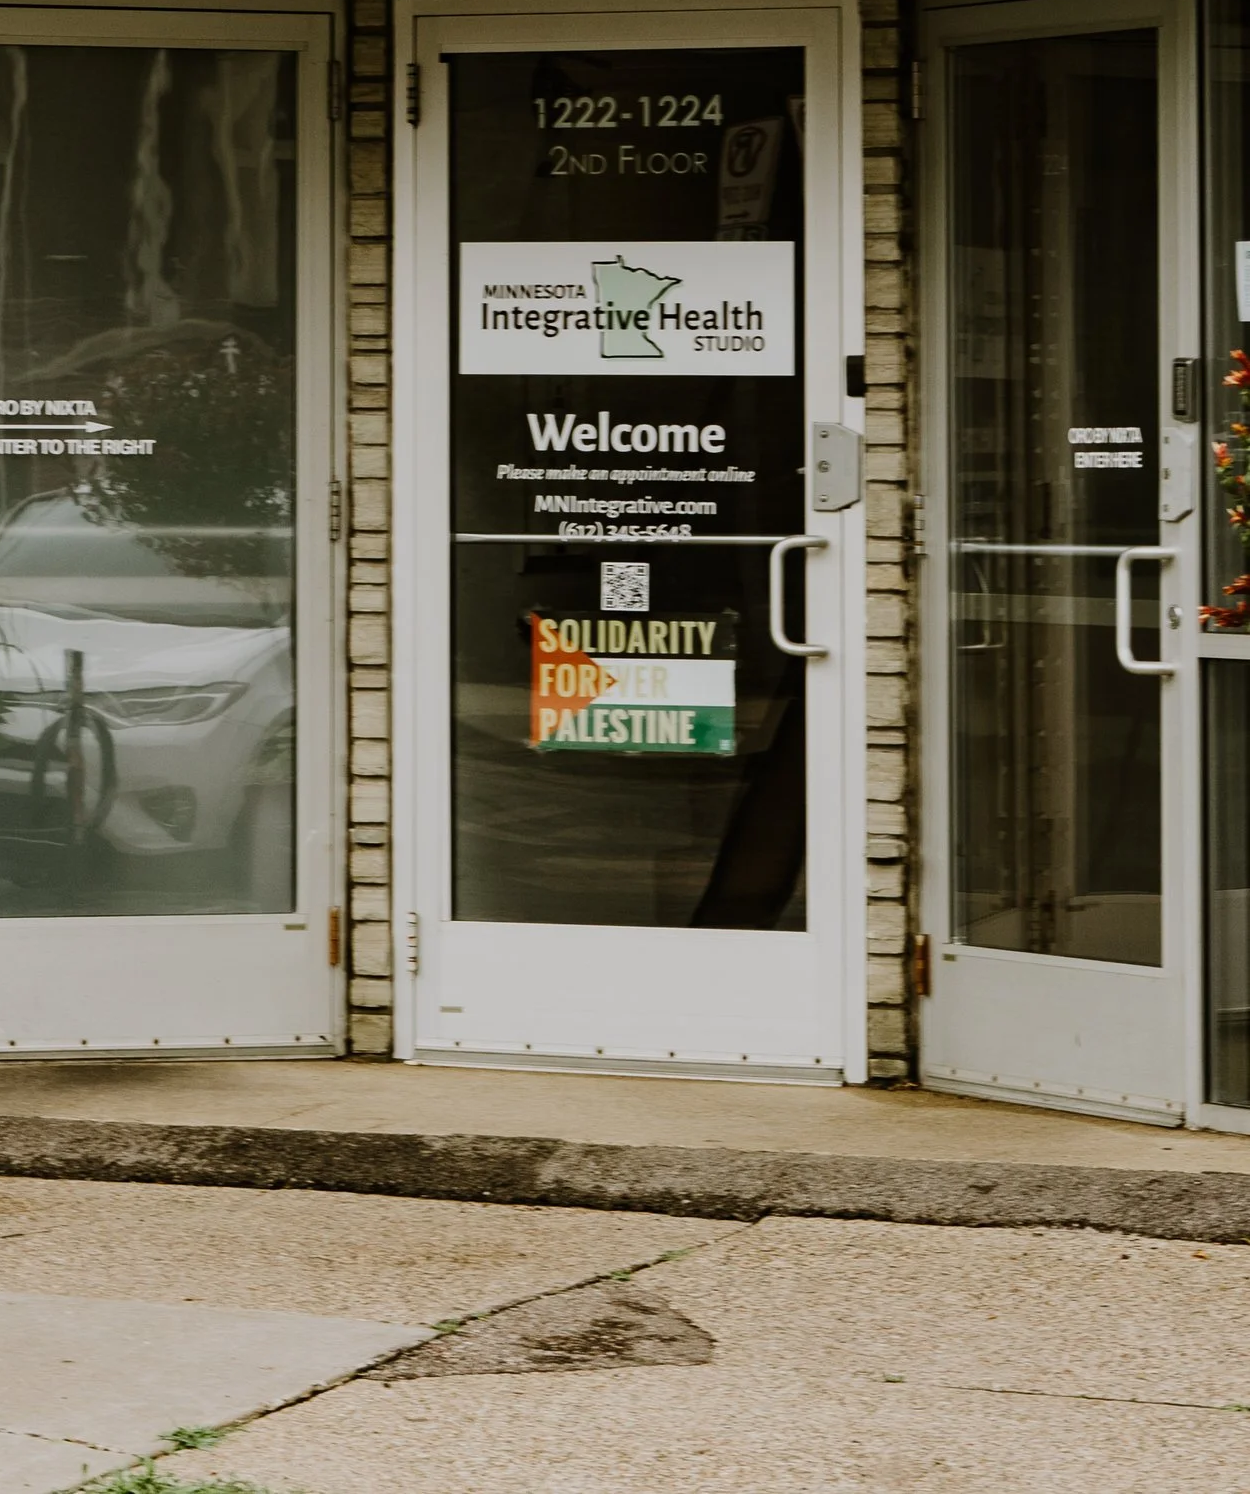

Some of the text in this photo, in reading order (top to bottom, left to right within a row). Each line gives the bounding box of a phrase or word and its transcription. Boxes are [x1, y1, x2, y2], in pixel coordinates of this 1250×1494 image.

[533, 94, 724, 130] 1222-1224
[483, 284, 587, 300] MINNESOTA
[481, 300, 764, 338] Integrative Health
[693, 335, 766, 352] STUDIO
[19, 400, 45, 416] BY
[37, 439, 65, 455] TO
[64, 439, 102, 455] THE
[102, 439, 157, 455] RIGHT
[526, 410, 727, 454] Welcome
[496, 464, 756, 485] Please make an appointment online
[538, 618, 717, 655] SOLIDARITY
[538, 662, 670, 699] FOREVER
[539, 709, 696, 745] PALESTINE
